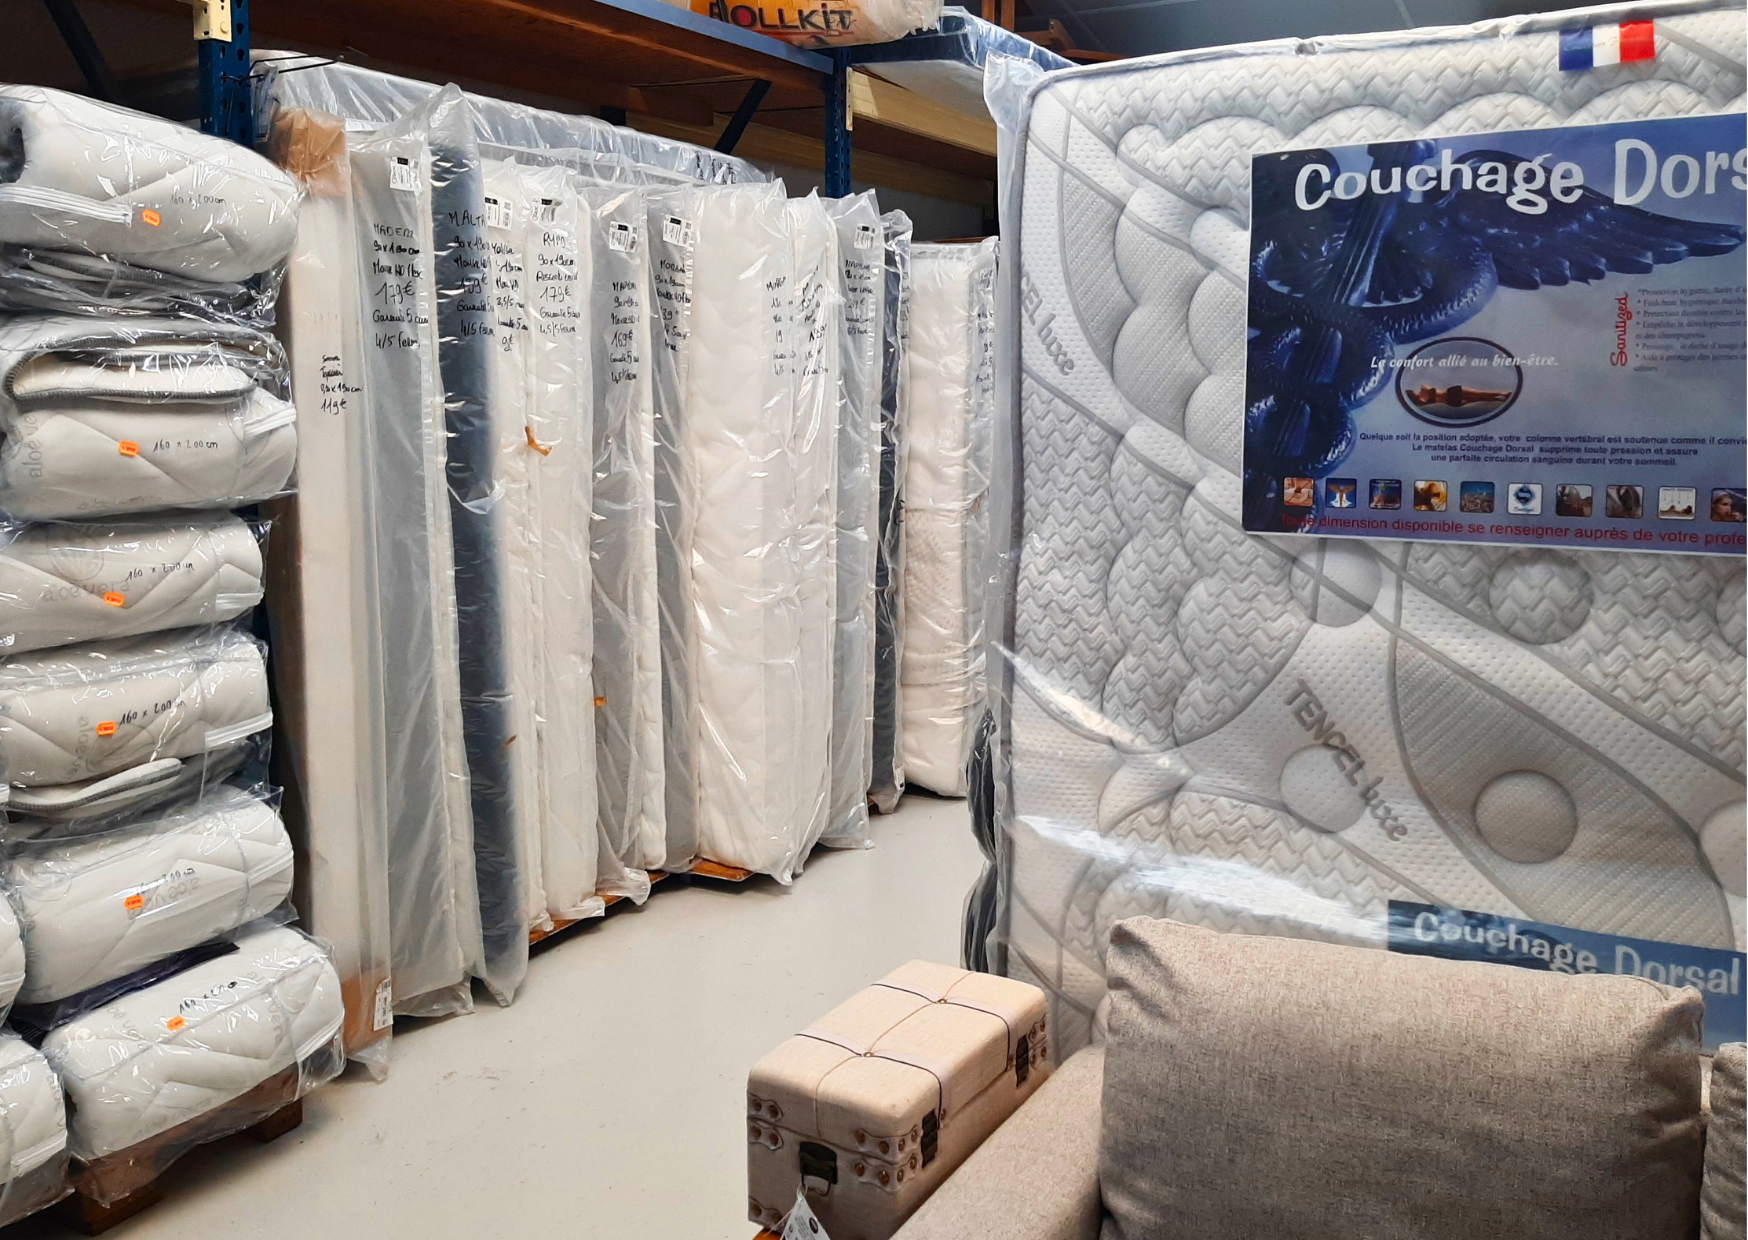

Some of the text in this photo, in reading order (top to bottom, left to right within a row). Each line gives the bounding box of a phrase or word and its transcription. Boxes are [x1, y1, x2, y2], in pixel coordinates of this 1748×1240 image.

[1295, 149, 1585, 215] Couchage
[1037, 313, 1075, 376] luxe
[1610, 291, 1633, 366] Sanitized
[1389, 355, 1433, 370] confort
[1438, 354, 1465, 367] allié
[1471, 358, 1489, 367] au
[1492, 353, 1560, 367] bien-être.
[1359, 432, 1394, 442] Quelque
[1395, 432, 1412, 441] soit
[1413, 432, 1421, 441] la
[1422, 432, 1457, 442] position
[1623, 435, 1668, 444] soutenue
[1670, 437, 1706, 445] comme
[1412, 443, 1422, 451] Le
[1424, 443, 1459, 451] matelas
[1459, 444, 1503, 454] Couchage
[1505, 444, 1534, 453] Dorsal
[1610, 446, 1652, 455] pression
[1654, 447, 1664, 455] et
[1449, 454, 1482, 463] parfaite
[1483, 454, 1530, 463] circulation
[1532, 455, 1573, 465] sanguine
[1607, 457, 1632, 465] votre
[1319, 516, 1388, 529] dimension
[1392, 518, 1463, 533] disponible
[1468, 524, 1485, 533] se
[1489, 523, 1570, 538] renseigner
[1574, 526, 1628, 541] auprès
[1633, 527, 1654, 541] de
[1658, 530, 1699, 544] votre
[1284, 678, 1409, 842] TENCEL luxe
[1413, 911, 1740, 995] Couchage Dorsal
